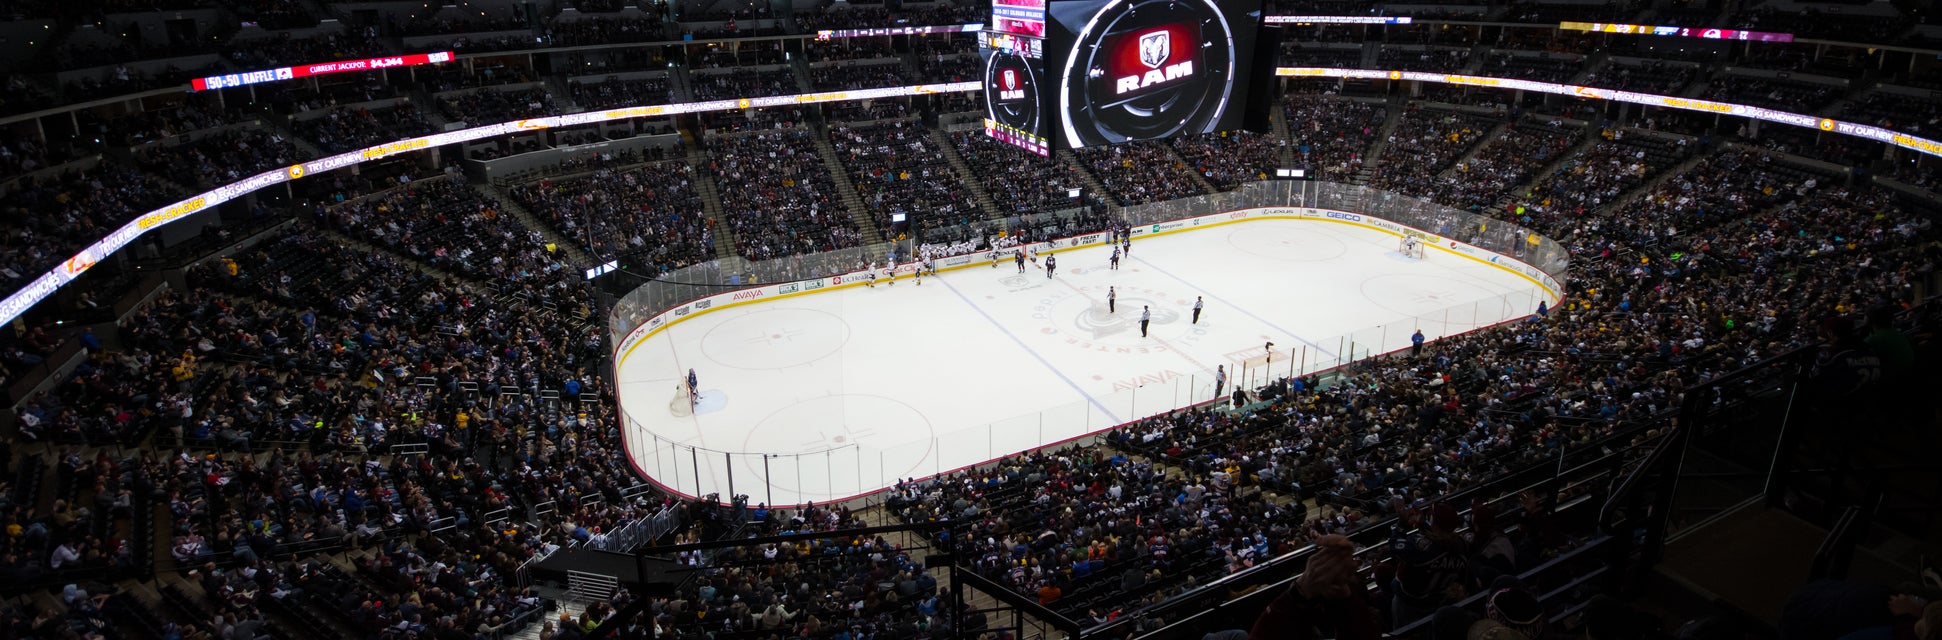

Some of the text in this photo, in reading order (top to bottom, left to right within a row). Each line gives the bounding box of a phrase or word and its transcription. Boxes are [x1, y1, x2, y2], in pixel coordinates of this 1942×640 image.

[1638, 26, 1645, 34] 0
[1682, 28, 1689, 36] 2
[241, 69, 275, 85] RAFFLE
[309, 62, 337, 74] CURRENT
[338, 60, 367, 71] JACKPOT:
[1116, 61, 1193, 94] RAM
[1001, 90, 1025, 99] RAM
[692, 100, 735, 111] SANDWICHES
[1623, 93, 1641, 101] OUR
[1641, 96, 1660, 104] NEW
[1747, 107, 1764, 118] EGG
[1764, 110, 1816, 127] SANDWICHES
[1838, 123, 1855, 134] TRY
[1855, 125, 1875, 137] OUR
[1875, 129, 1893, 142] NEW
[307, 161, 324, 173] TRY
[324, 157, 342, 168] OUR
[342, 152, 361, 164] NEW
[99, 171, 285, 255] TRY OUR NEW FRESH-CRACKED EGG SANDWICHES
[1230, 211, 1249, 220] xfinity
[1326, 211, 1361, 222] GEICO
[1373, 219, 1401, 233] CAMBRIA
[1080, 234, 1100, 242] FREAKY
[10, 272, 60, 314] SANDWICHES
[733, 289, 764, 301] AVAYA
[1112, 370, 1184, 392] AVAYA
